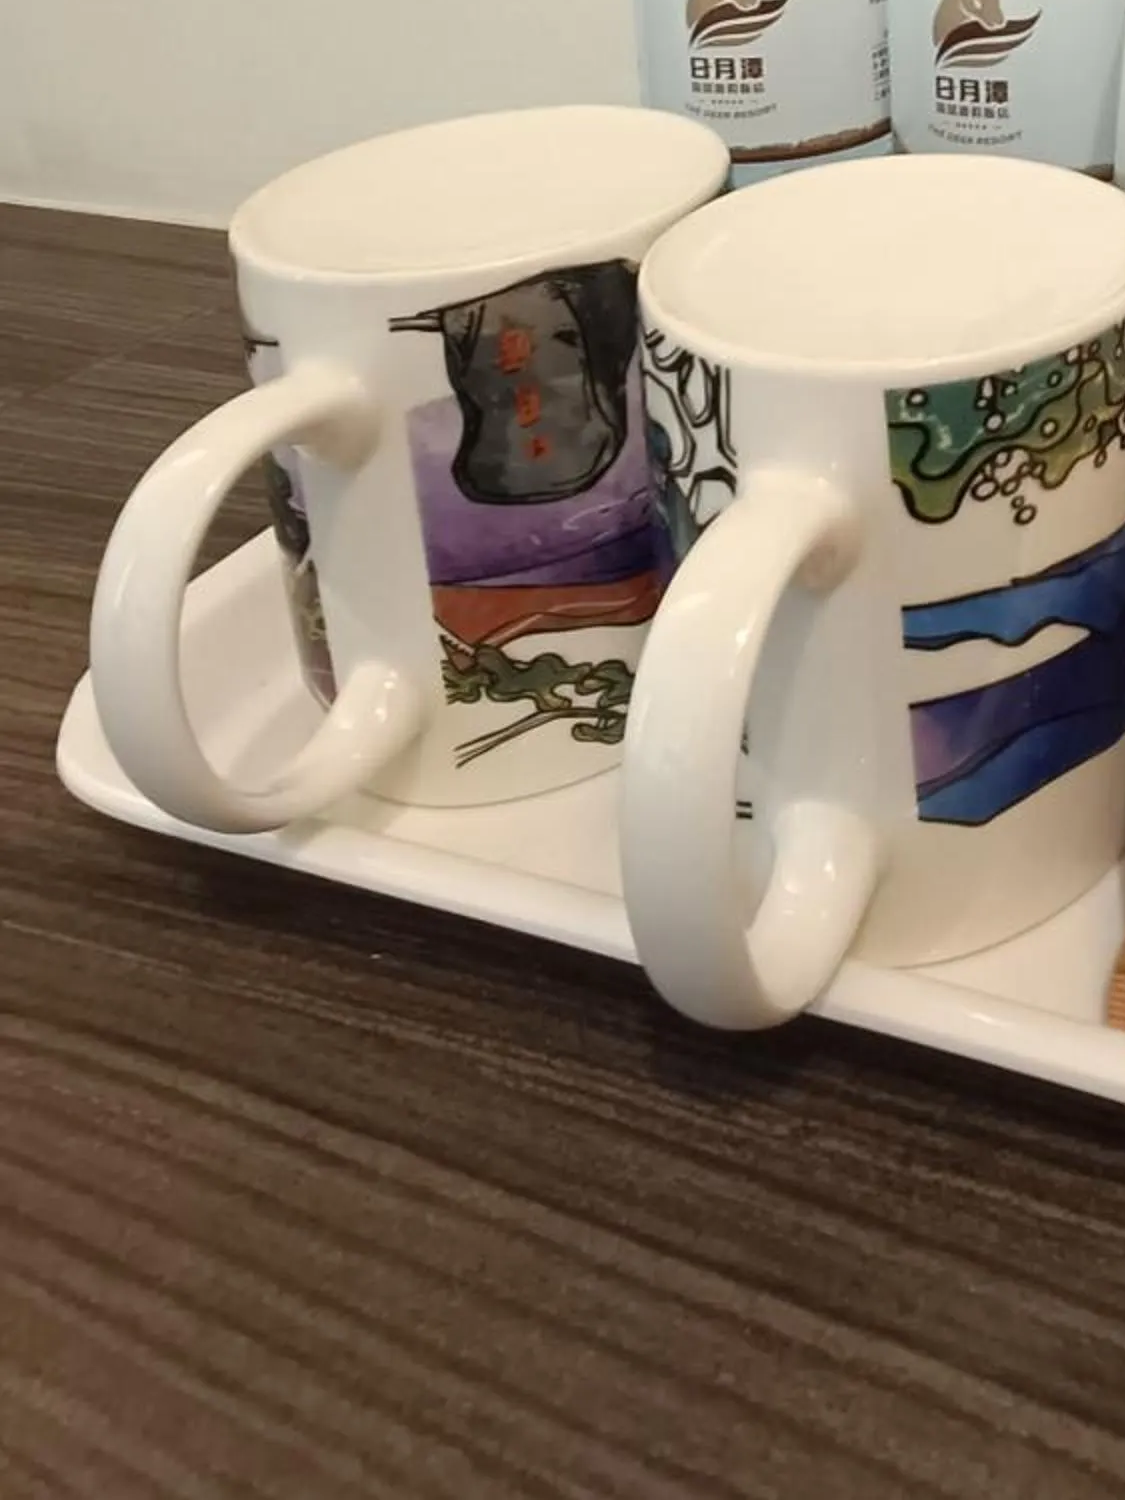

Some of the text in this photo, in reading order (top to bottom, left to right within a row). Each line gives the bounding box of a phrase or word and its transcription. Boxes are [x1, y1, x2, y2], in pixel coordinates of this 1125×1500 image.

[690, 56, 764, 80] 日月潭
[936, 75, 1009, 104] 日月潭
